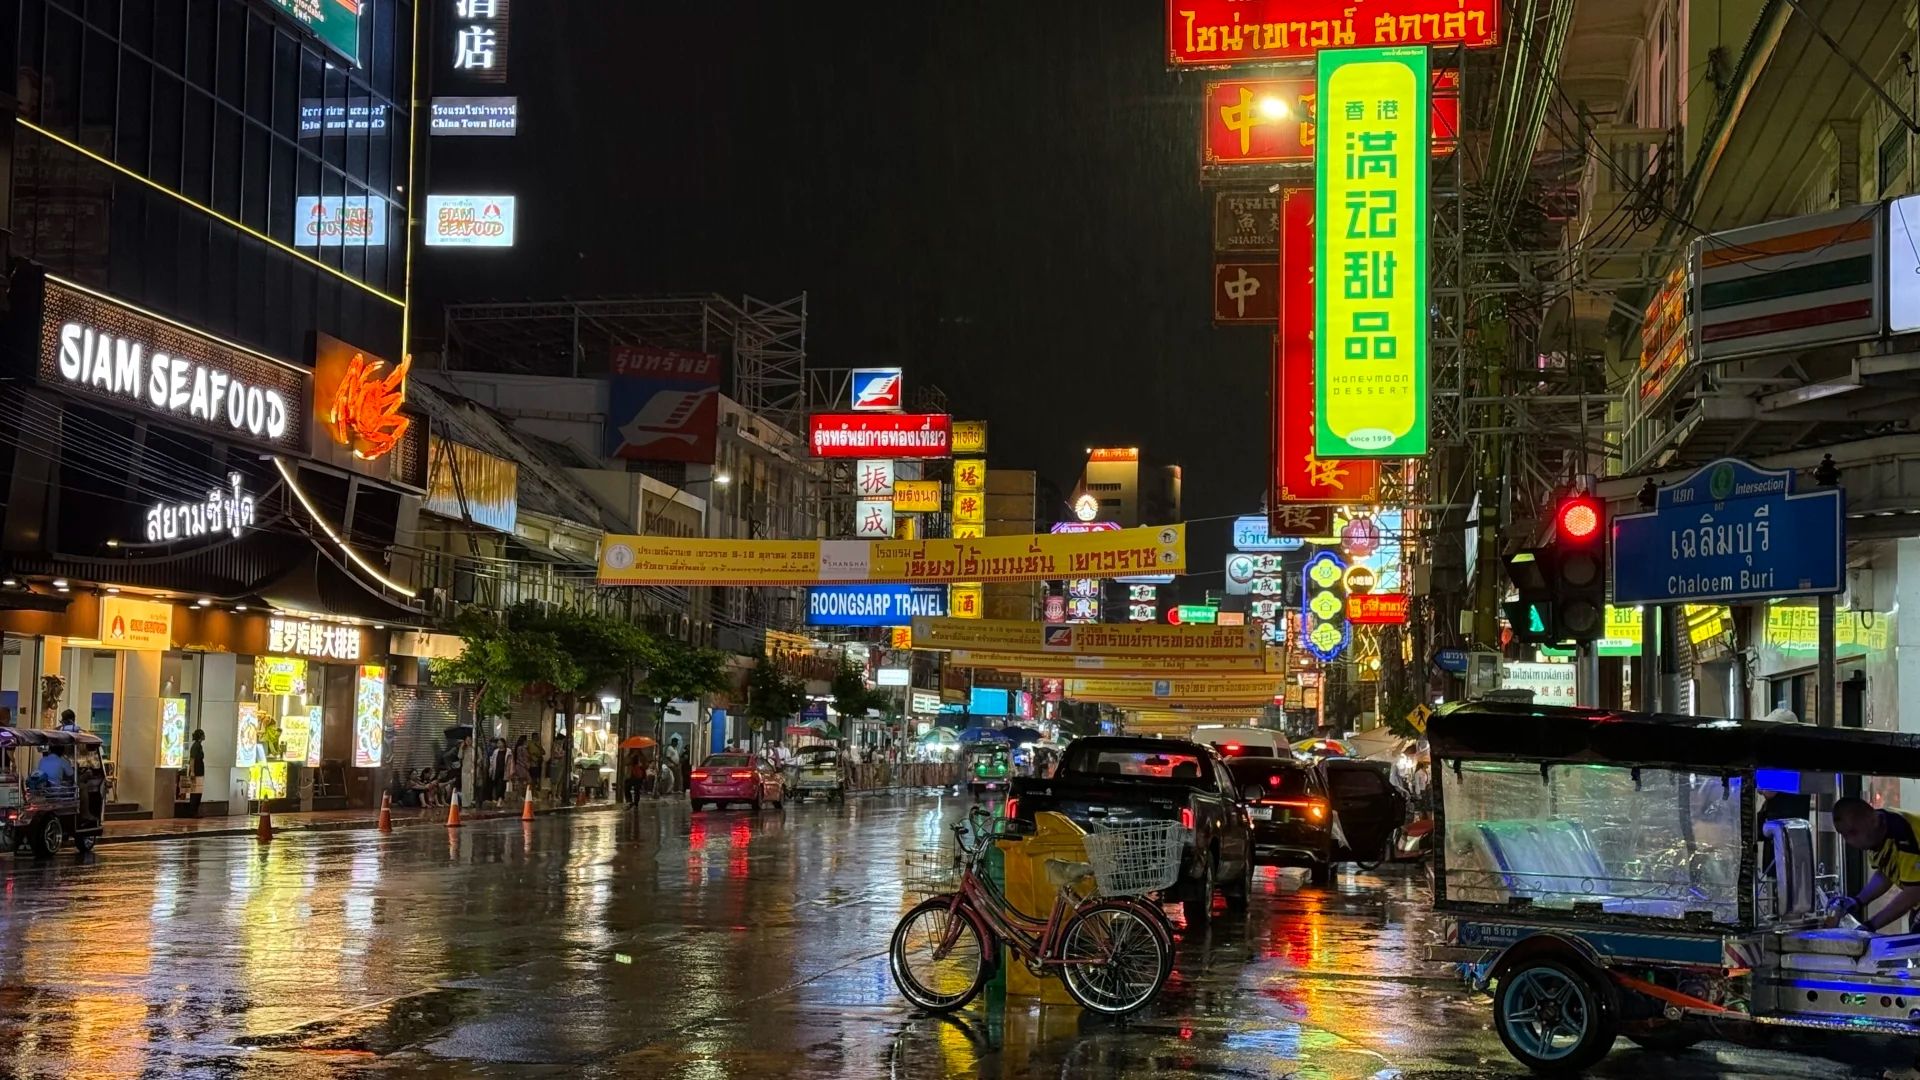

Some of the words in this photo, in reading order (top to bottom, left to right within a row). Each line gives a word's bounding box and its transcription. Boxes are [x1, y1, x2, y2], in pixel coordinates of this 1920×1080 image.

[1181, 7, 1358, 52] ไชน่าทาวน์
[1374, 0, 1487, 44] สกาล่า
[432, 104, 516, 115] โรงแรมไชน่าทาวน์
[1345, 100, 1398, 120] 香港
[432, 119, 460, 128] China
[461, 119, 487, 128] Town
[488, 119, 514, 128] Hotel
[438, 207, 476, 222] SIAM
[438, 220, 505, 237] SEAFOOD
[1224, 267, 1261, 318] 中
[616, 349, 716, 375] รุ่งทรัพย์
[57, 322, 144, 399] SIAM
[148, 352, 288, 440] SEAFOOD
[1333, 375, 1408, 383] HONEYMOON
[1333, 387, 1408, 395] DESSERT
[814, 417, 947, 454] รุ่งทรัพย์การท่องเที่ยว
[1672, 488, 1694, 503] แยก
[1735, 478, 1785, 495] Intersection
[146, 471, 254, 541] สยามซีฟู้ด
[860, 464, 892, 535] 振成
[1671, 504, 1770, 567] เฉลิมบุรี
[875, 544, 911, 558] โรงแรม
[1069, 547, 1157, 572] เยาวราช
[1668, 576, 1733, 595] Chaloem
[1740, 568, 1774, 591] Buri
[811, 591, 891, 616] ROONGSARP
[895, 593, 944, 617] TRAVEL
[1076, 625, 1244, 652] รุ่งทรัพย์การท่องเที่ยว
